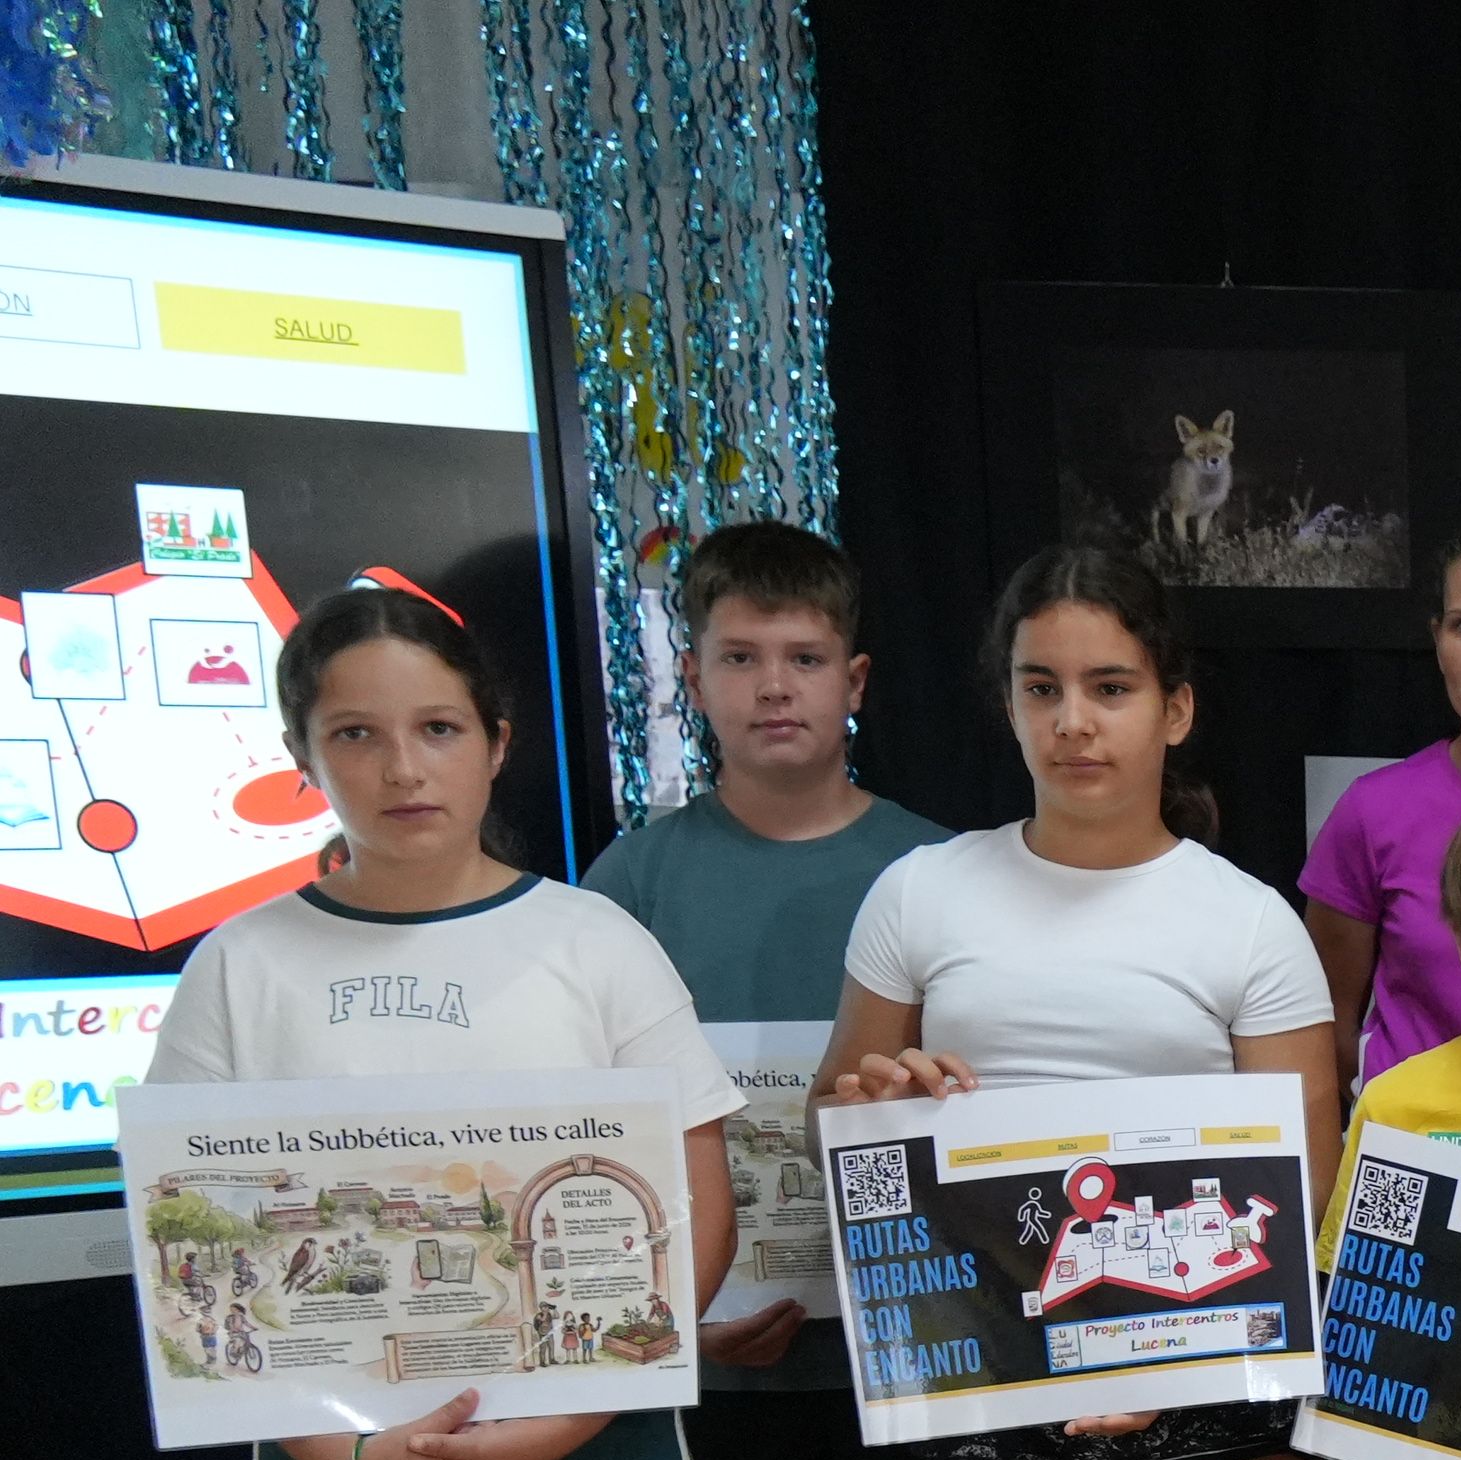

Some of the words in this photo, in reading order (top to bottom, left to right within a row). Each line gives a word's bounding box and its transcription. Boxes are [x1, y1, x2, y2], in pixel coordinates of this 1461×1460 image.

[273, 317, 354, 343] SALUD
[329, 975, 470, 1029] FILA
[187, 1132, 271, 1158] Siente
[276, 1129, 302, 1154] la
[308, 1125, 446, 1153] Subbética,
[450, 1122, 504, 1145] vive
[509, 1120, 548, 1143] tus
[554, 1117, 625, 1142] calles
[560, 1188, 612, 1199] DETALLES
[562, 1200, 583, 1209] DEL
[584, 1199, 612, 1208] ACTO
[846, 1216, 931, 1261] RUTAS
[1337, 1233, 1425, 1289] RUTAS
[852, 1252, 978, 1303] URBANAS
[859, 1303, 914, 1345] CON
[1085, 1319, 1146, 1338] Proyecto
[1151, 1309, 1240, 1329] Intercentros
[1329, 1275, 1457, 1343] URBANAS
[864, 1337, 982, 1387] ENCANTO
[1131, 1335, 1188, 1353] Lucena
[1322, 1317, 1377, 1365] CON
[1326, 1360, 1430, 1425] NCANTO
